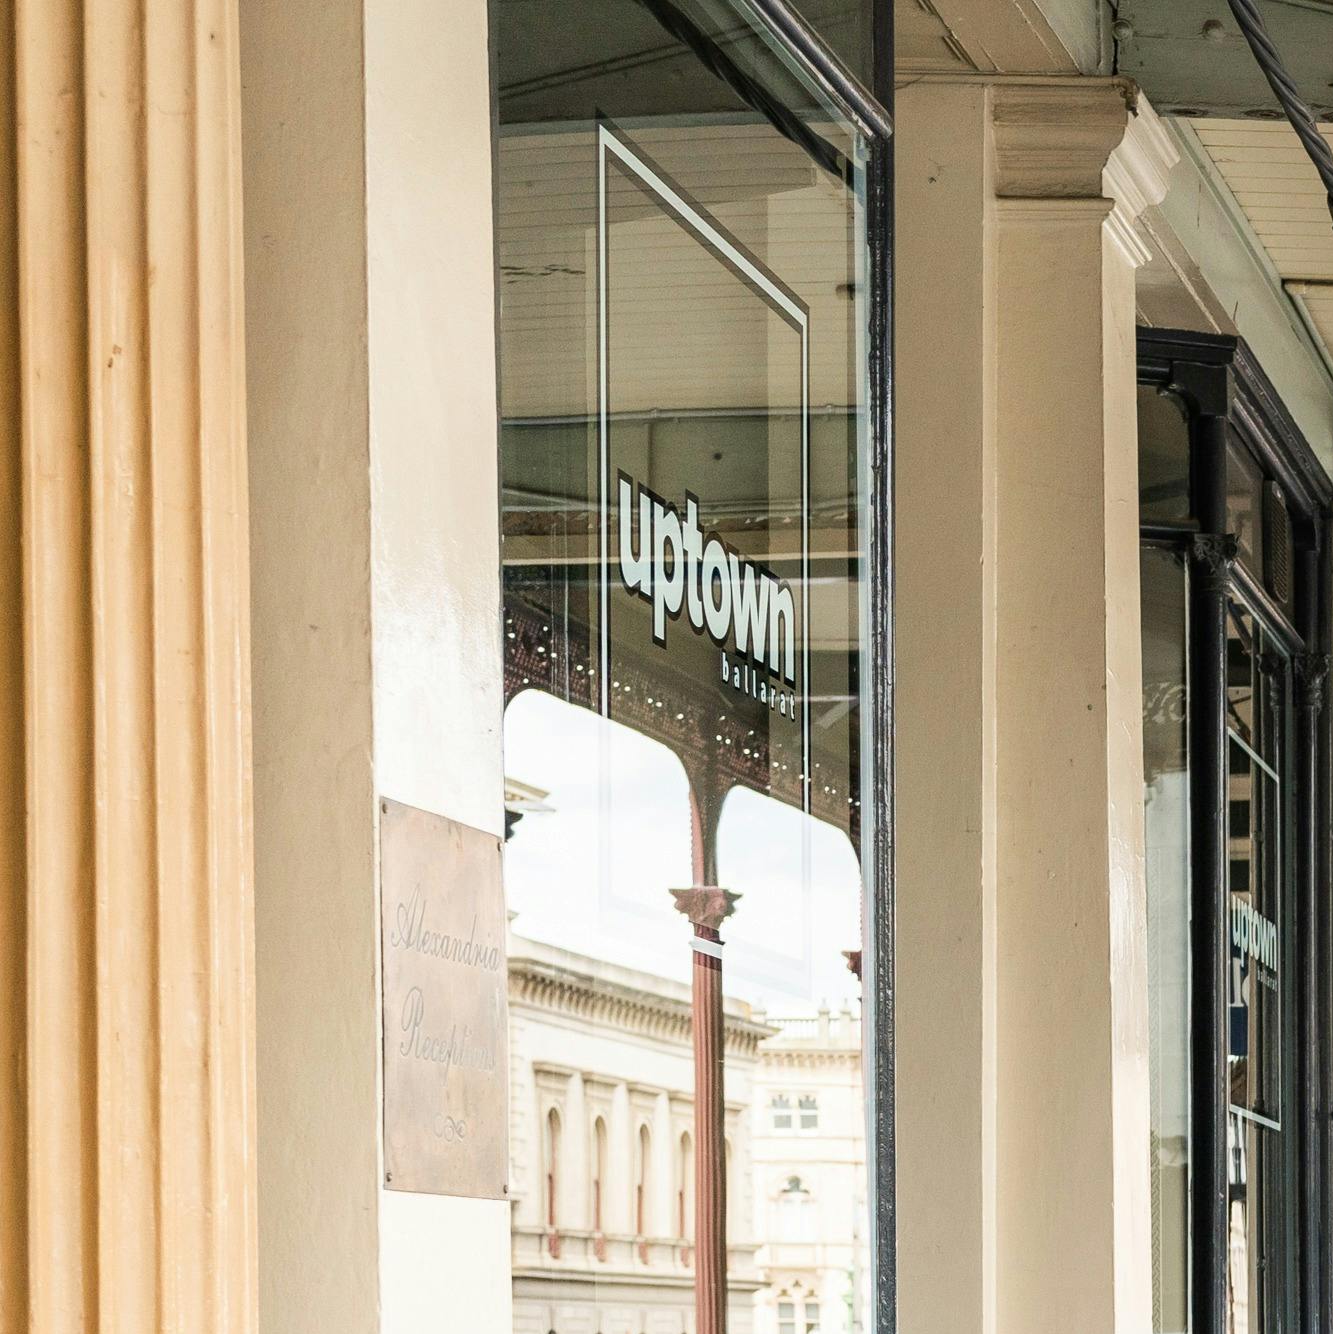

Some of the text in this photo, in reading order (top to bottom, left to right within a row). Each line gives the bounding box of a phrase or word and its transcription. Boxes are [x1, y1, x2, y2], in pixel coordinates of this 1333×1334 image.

[618, 472, 796, 688] uptown
[721, 650, 796, 721] ballarat
[391, 883, 500, 971] Alexandria
[1232, 893, 1277, 972] uptown
